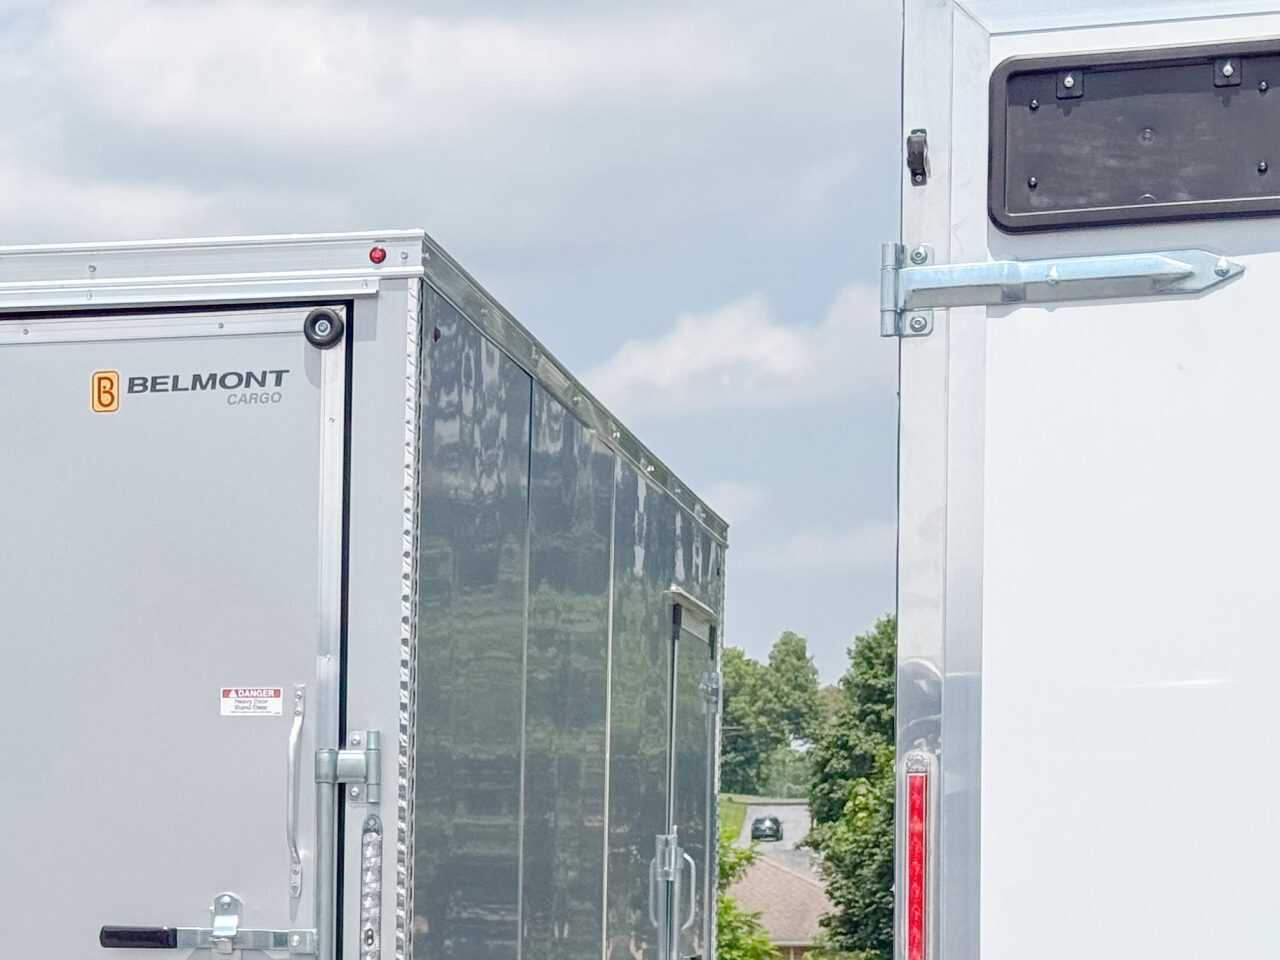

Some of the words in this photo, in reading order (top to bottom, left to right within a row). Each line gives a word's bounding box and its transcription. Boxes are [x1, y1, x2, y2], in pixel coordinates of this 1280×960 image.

[127, 369, 290, 394] BELMONT
[227, 391, 282, 406] CARGO
[238, 689, 274, 697] DANGER
